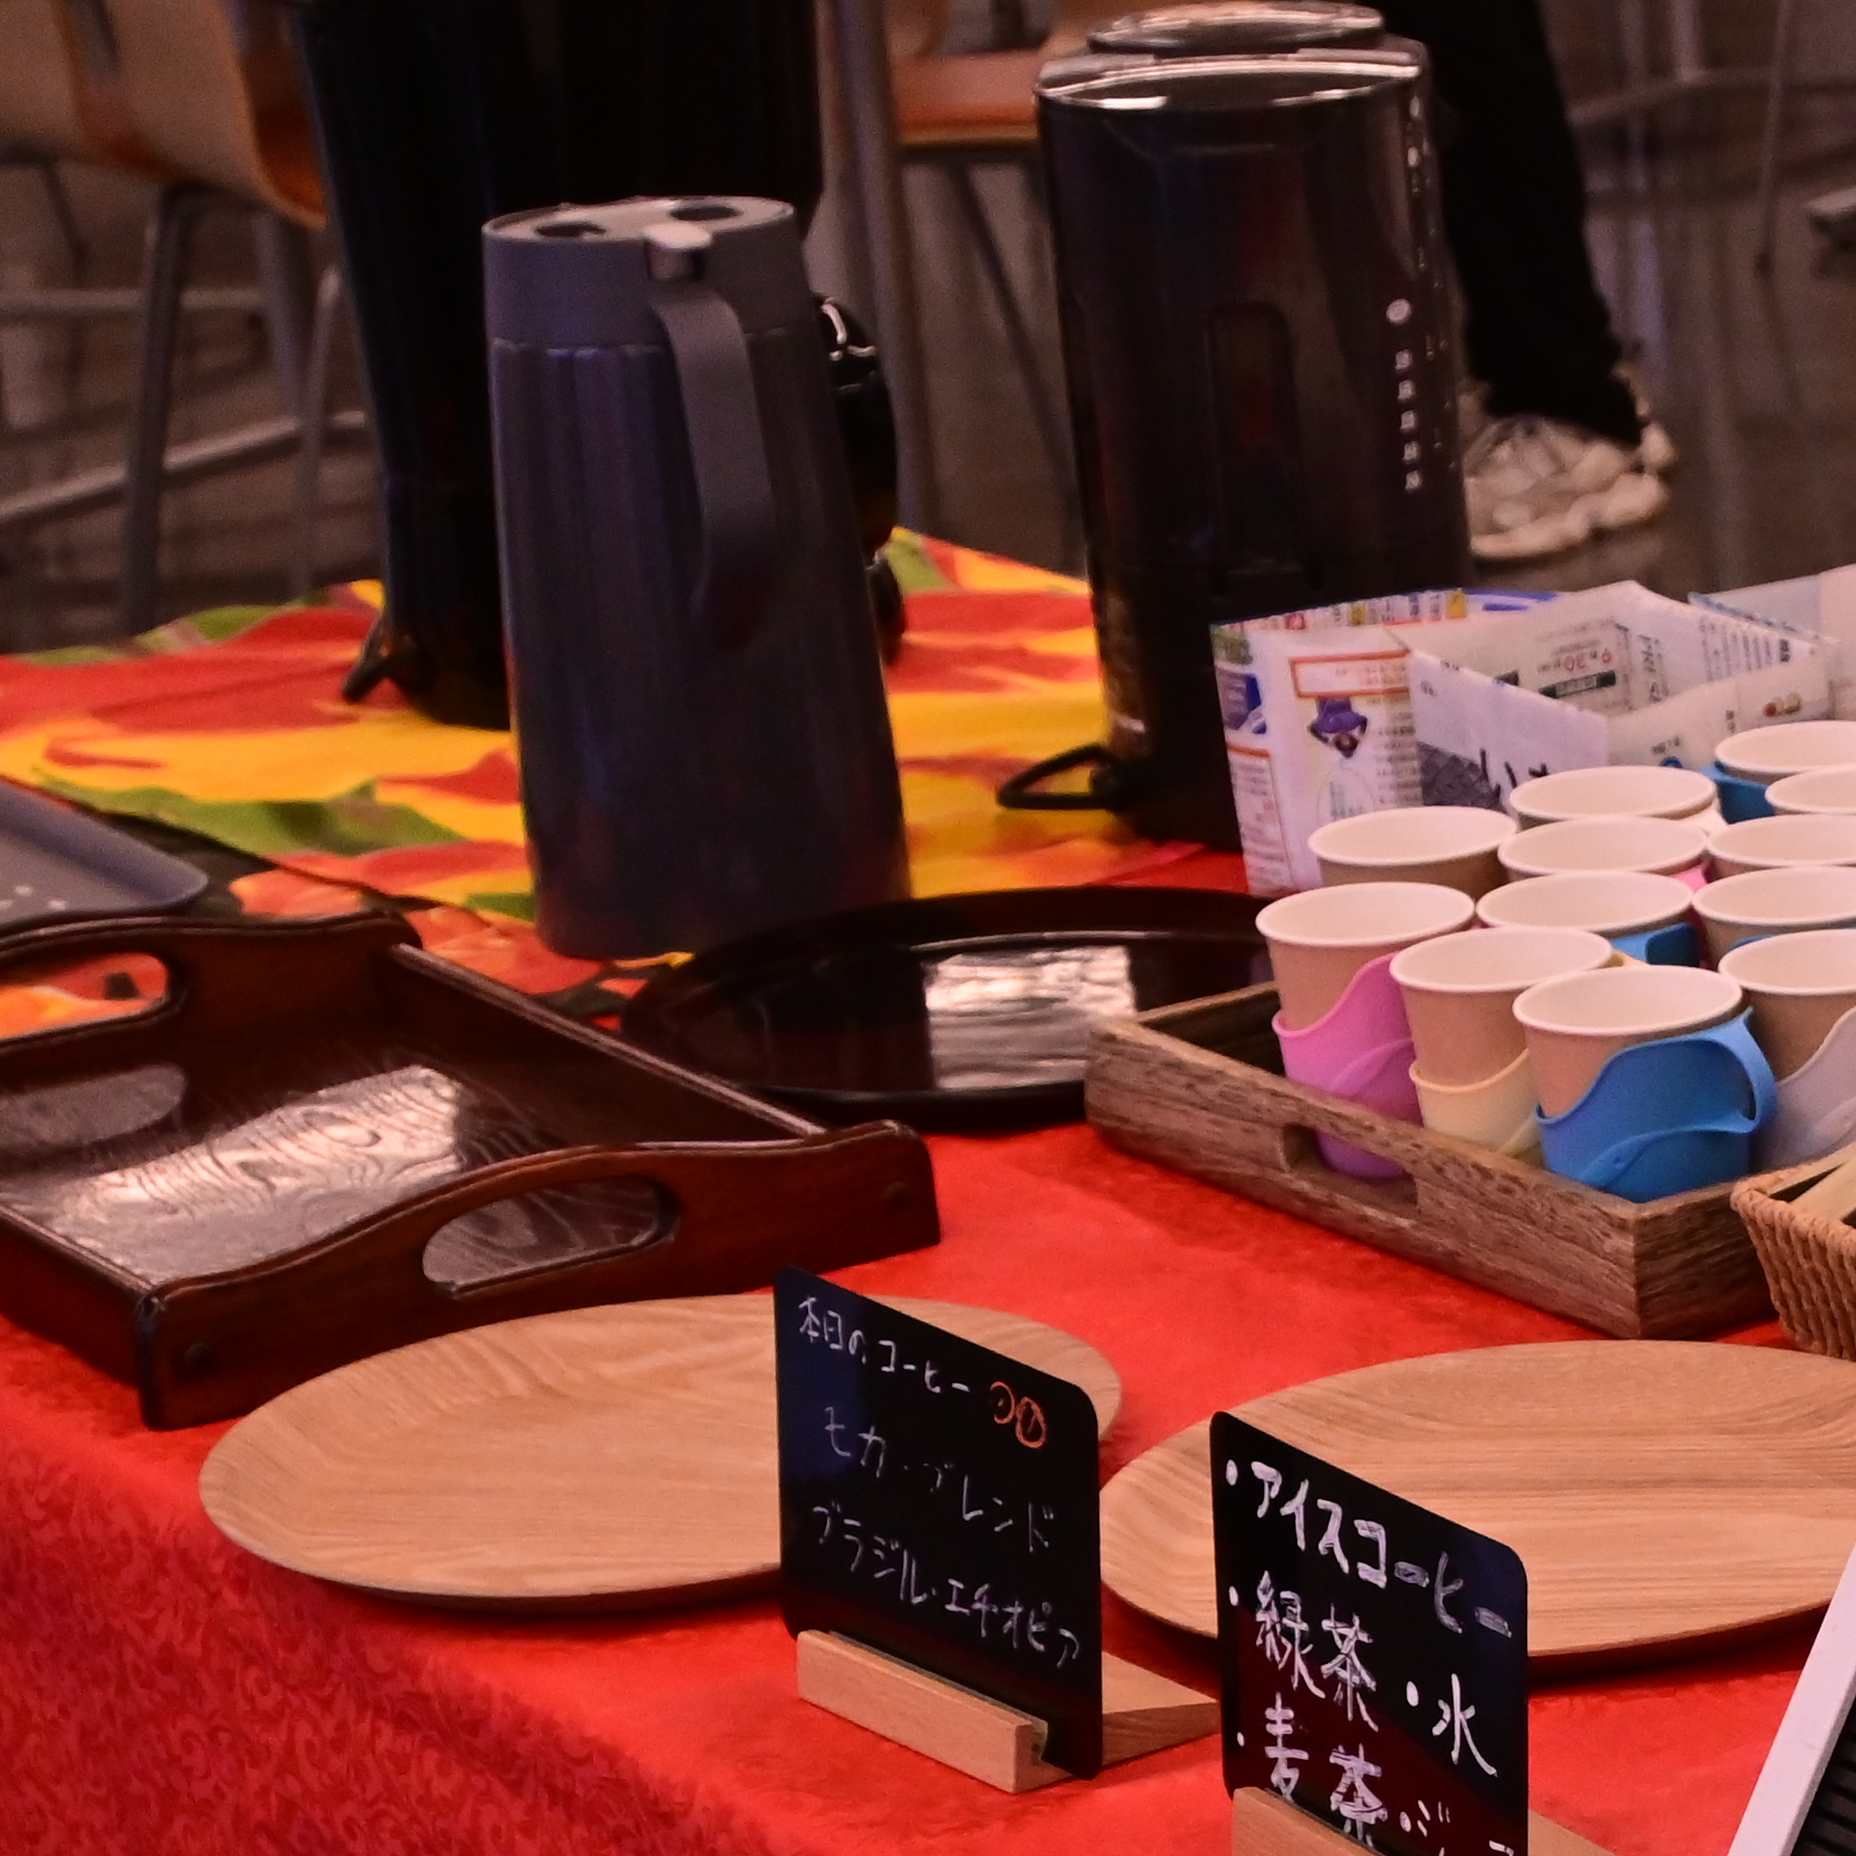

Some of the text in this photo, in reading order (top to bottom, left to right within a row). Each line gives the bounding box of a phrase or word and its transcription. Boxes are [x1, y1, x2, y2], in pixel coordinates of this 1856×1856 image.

[798, 1296, 970, 1395] 本日のコーヒー
